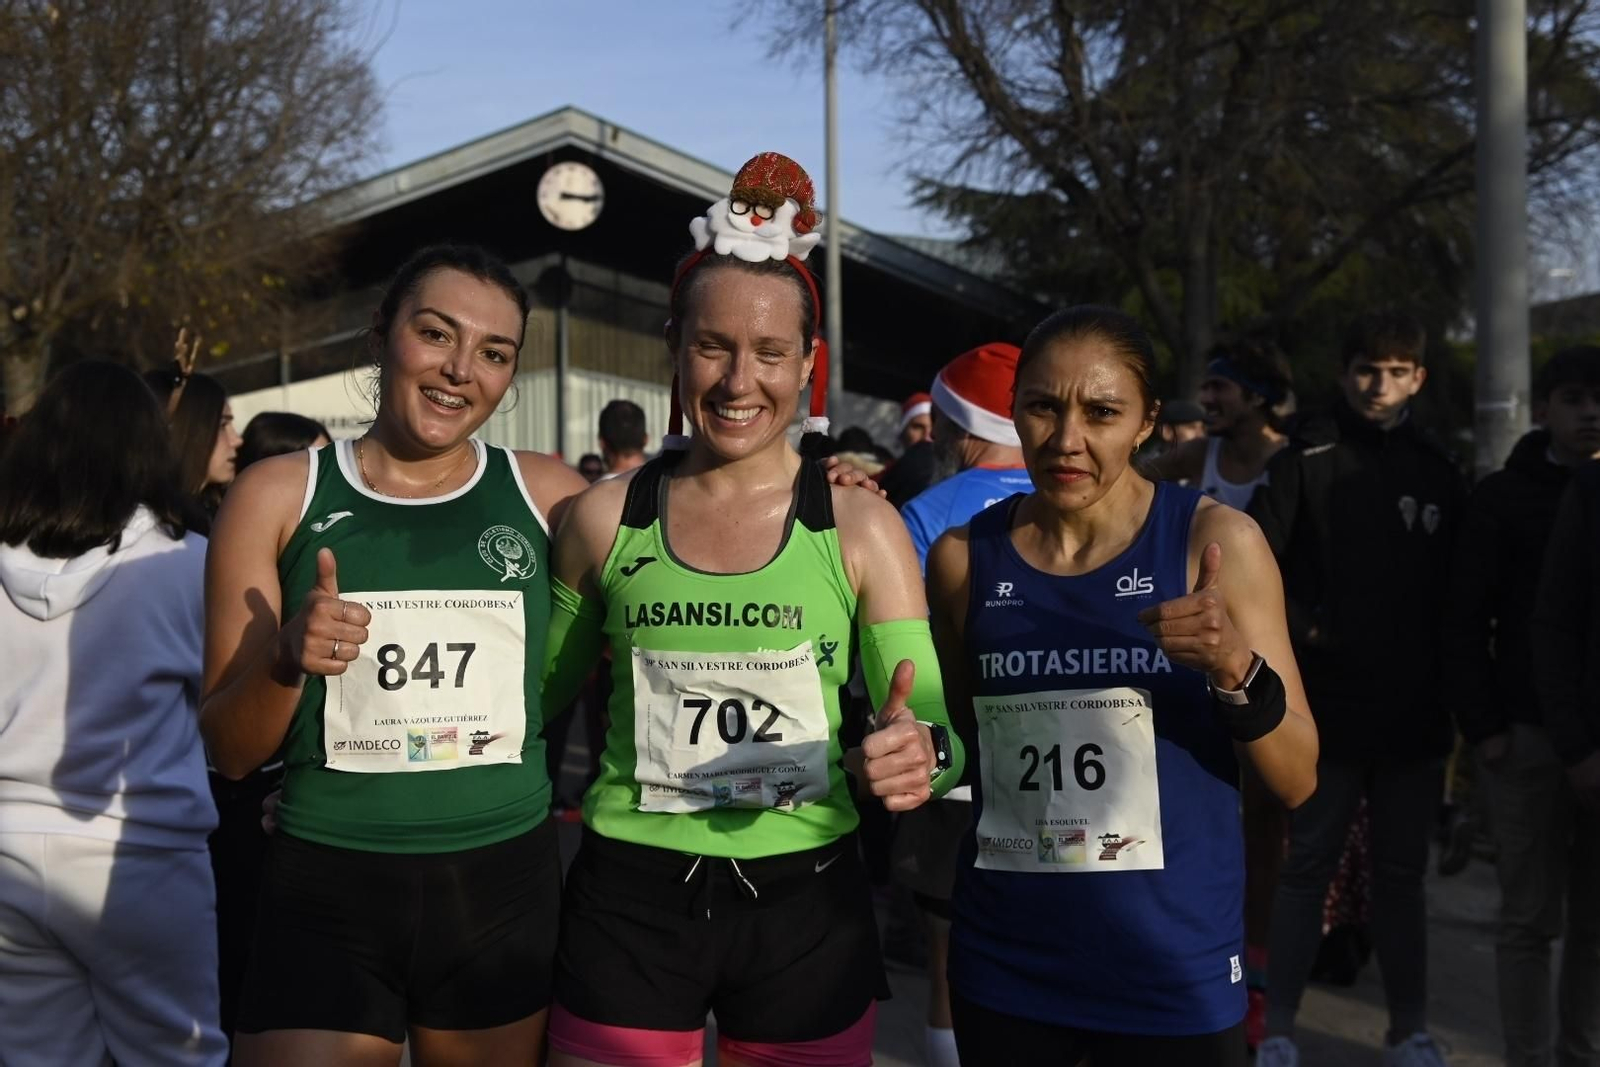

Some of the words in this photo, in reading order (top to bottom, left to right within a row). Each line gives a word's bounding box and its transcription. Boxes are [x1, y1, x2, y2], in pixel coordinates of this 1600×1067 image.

[376, 601, 442, 610] SILVESTRE
[444, 599, 514, 609] CORDOBESA
[625, 602, 803, 630] LASANSI.COM
[377, 642, 476, 691] 847
[658, 659, 679, 670] SAN
[680, 661, 743, 671] SILVESTRE
[746, 654, 810, 671] CORDOBESA
[979, 647, 1172, 679] TROTASIERRA
[996, 703, 1015, 713] SAN
[1015, 700, 1068, 713] SILVESTRE
[1070, 698, 1143, 709] CORDOBESA
[374, 718, 402, 727] LAURA
[444, 713, 488, 724] GUTIÉRREZ
[683, 698, 783, 745] 702
[349, 739, 401, 751] IMDECO
[1018, 743, 1106, 791] 216
[667, 771, 700, 780] CARMEN
[1050, 817, 1091, 826] ESQUIVEL
[992, 837, 1033, 850] IMDECO
